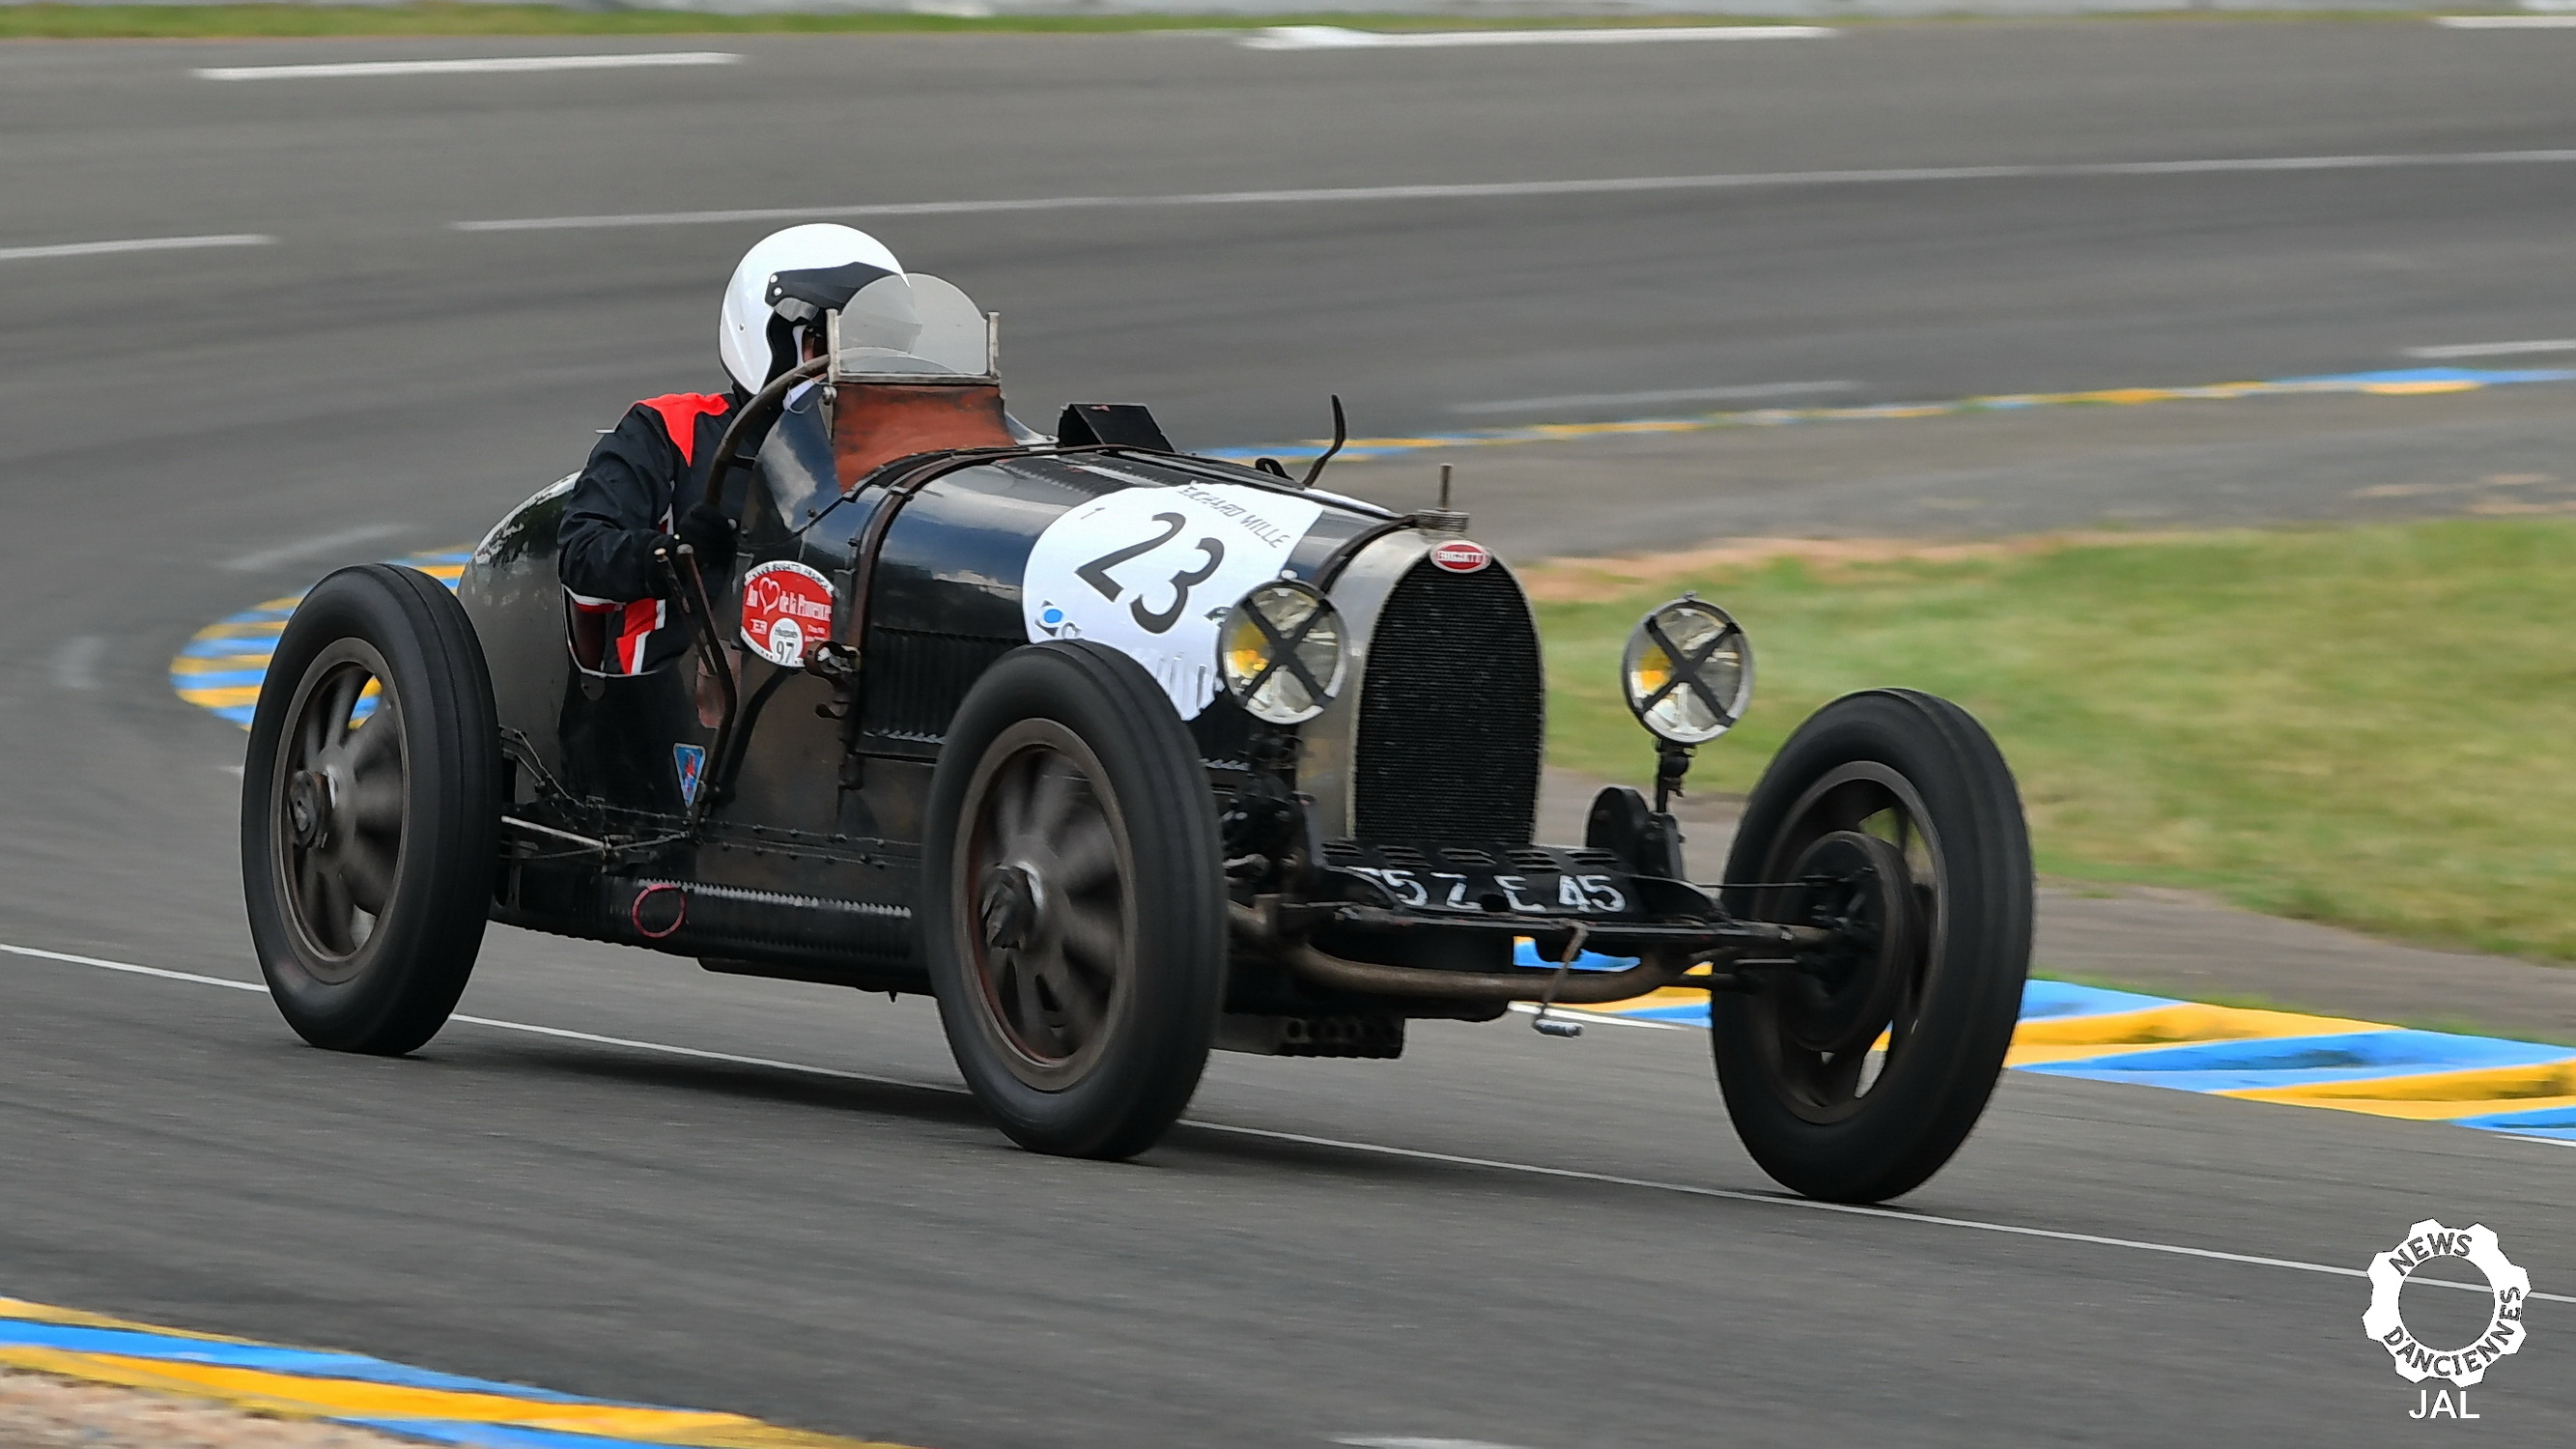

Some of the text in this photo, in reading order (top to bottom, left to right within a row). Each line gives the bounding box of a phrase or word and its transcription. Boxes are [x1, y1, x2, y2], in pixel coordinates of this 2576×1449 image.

[1240, 514, 1290, 549] MILLE
[1074, 511, 1225, 635] 23
[776, 639, 795, 664] 97
[1558, 874, 1627, 913] 45
